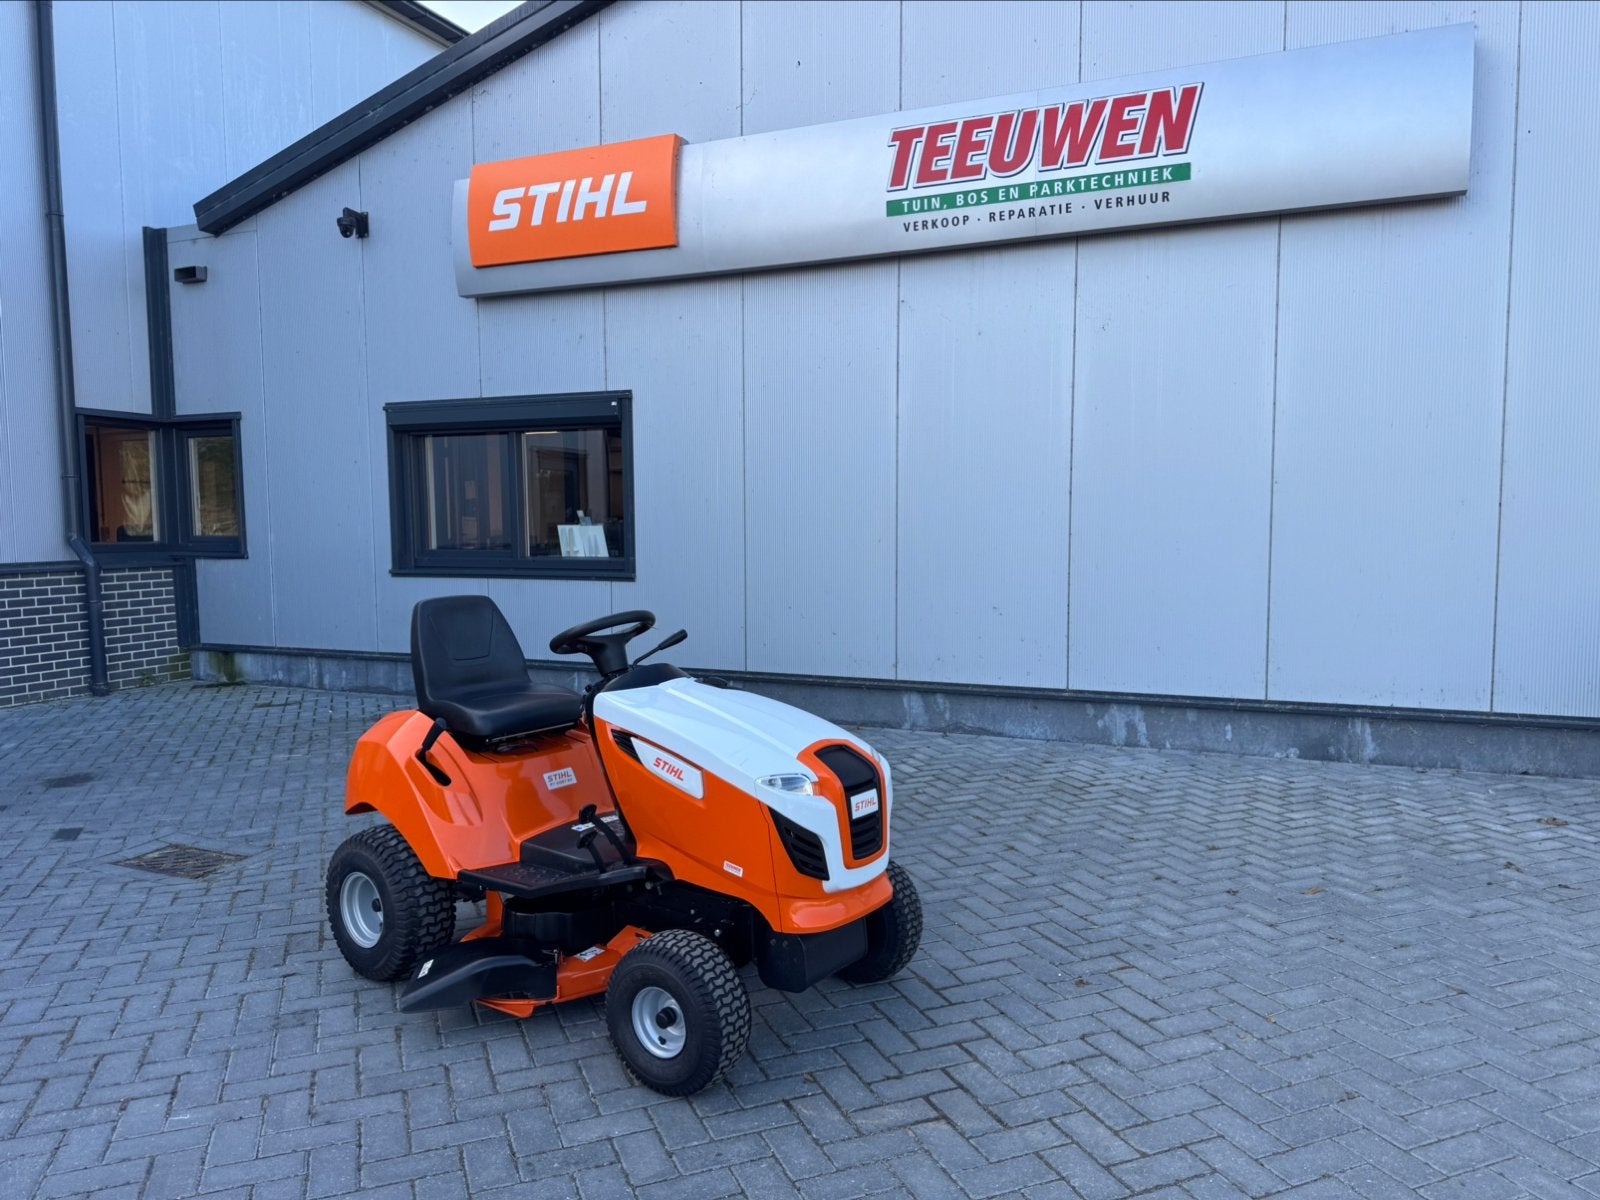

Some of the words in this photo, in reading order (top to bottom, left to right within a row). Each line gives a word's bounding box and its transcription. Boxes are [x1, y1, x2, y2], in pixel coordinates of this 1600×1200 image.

[887, 83, 1203, 191] TEEUWEN
[488, 171, 647, 232] STIHL
[902, 196, 947, 213] TUIN,
[956, 191, 988, 206] BOS
[998, 187, 1019, 200] EN
[1029, 167, 1173, 197] PARKTECHNIEK
[903, 215, 970, 233] VERKOOP
[989, 203, 1072, 223] REPARATIE
[1094, 191, 1170, 210] VERHUUR
[547, 770, 572, 783] STIHL
[653, 757, 684, 782] STIHL
[855, 796, 877, 812] STIHL
